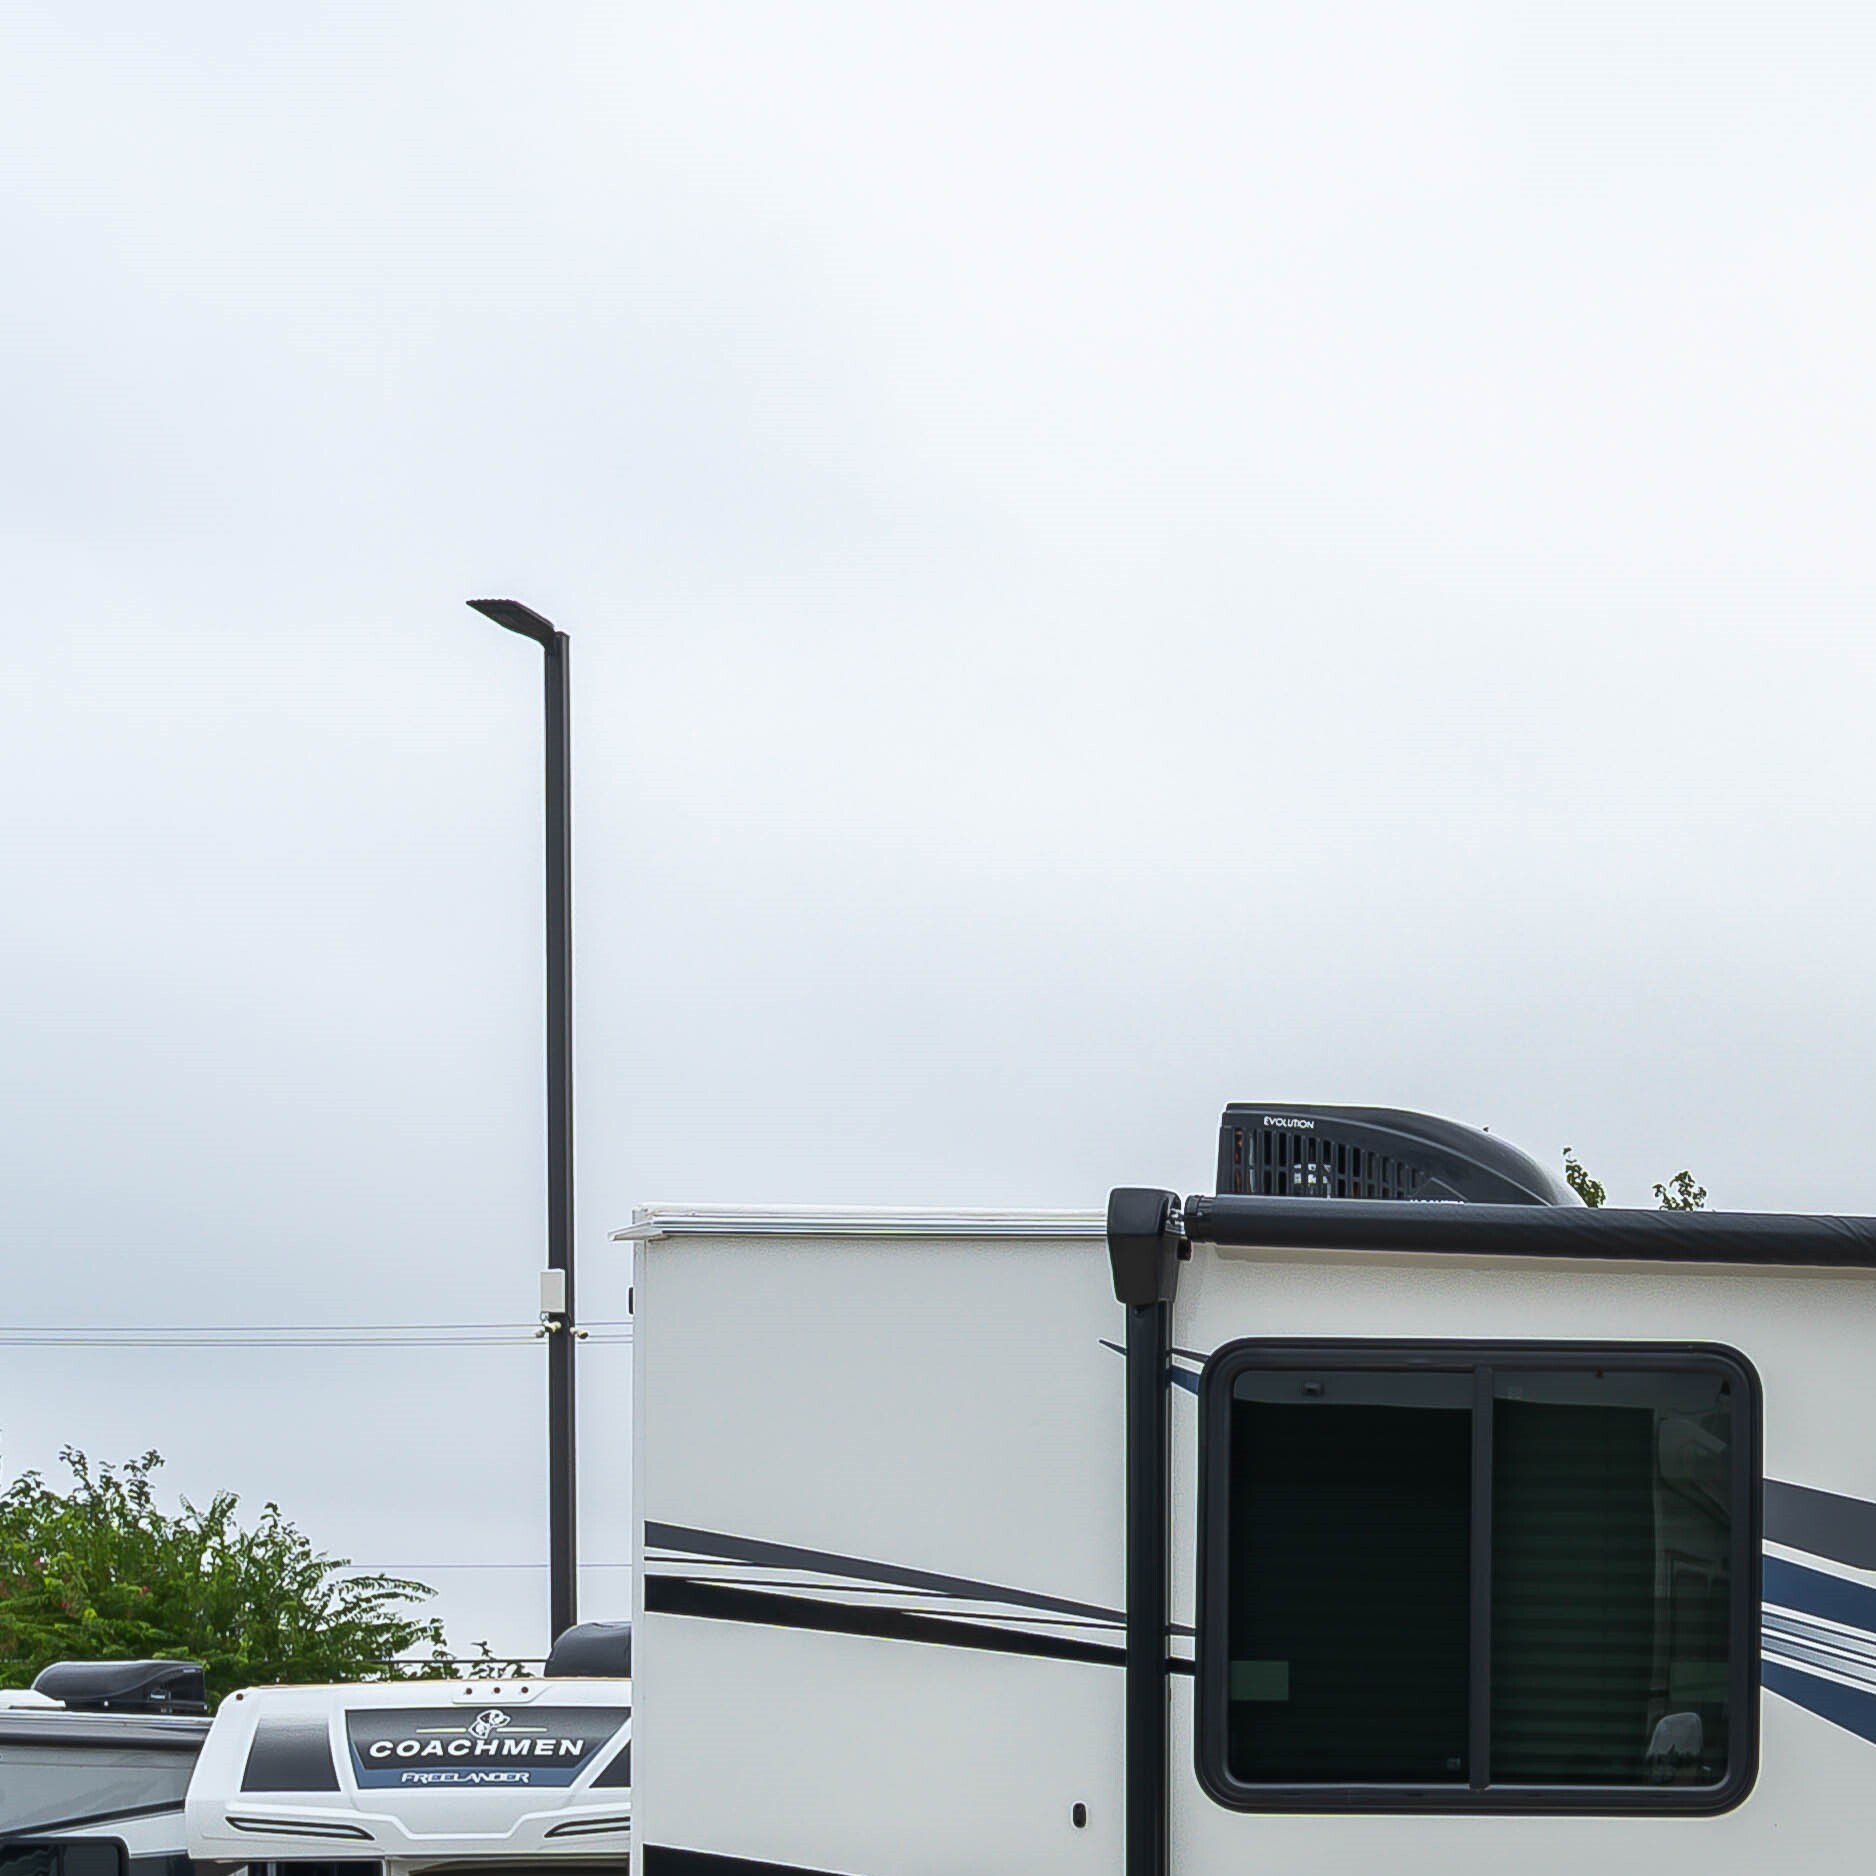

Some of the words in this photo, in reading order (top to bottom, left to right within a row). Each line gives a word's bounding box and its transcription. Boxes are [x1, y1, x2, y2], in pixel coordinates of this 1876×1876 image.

[1263, 1115, 1315, 1129] EVOLUTION
[369, 1739, 584, 1758] COACHMEN
[401, 1771, 530, 1784] FREELANDER
